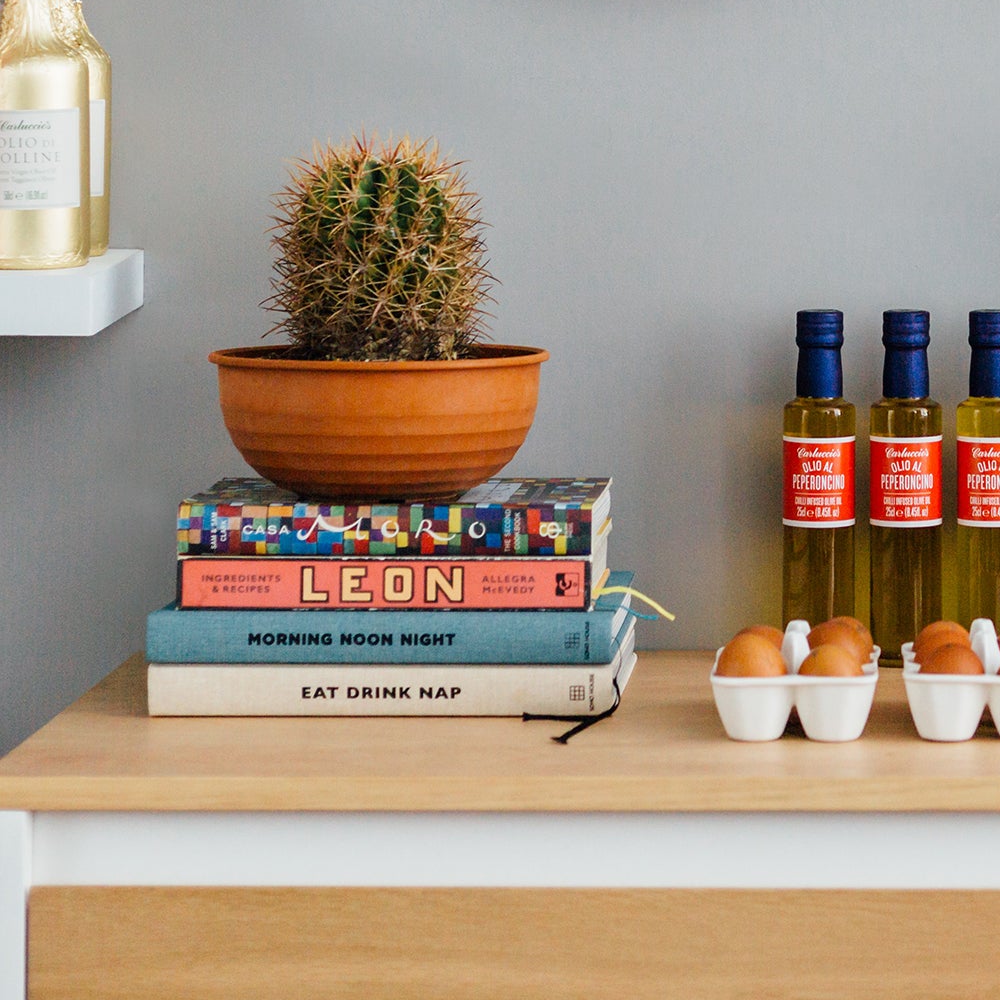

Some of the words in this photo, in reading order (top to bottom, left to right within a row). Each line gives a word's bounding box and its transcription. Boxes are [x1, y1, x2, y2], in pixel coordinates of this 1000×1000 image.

[797, 447, 841, 459] Carluccio's
[885, 447, 929, 459] Carluccio's
[802, 460, 822, 473] OLIO
[823, 460, 834, 474] AL
[890, 460, 911, 473] OLIO
[912, 460, 923, 474] AL
[977, 460, 997, 473] OLIO
[792, 474, 845, 490] PEPERONCINO
[881, 474, 934, 490] PEPERONCINO
[242, 525, 290, 535] CASA
[202, 575, 281, 583] INGREDIENTS
[300, 565, 464, 603] LEON
[482, 575, 535, 583] ALLEGRA
[212, 585, 219, 593] &
[223, 585, 270, 593] RECIPES
[482, 586, 535, 594] McEVEDY
[247, 632, 333, 646] MORNING
[340, 632, 393, 646] NOON
[401, 632, 456, 646] NIGHT
[301, 686, 339, 699] EAT
[347, 686, 411, 699] DRINK
[419, 686, 462, 699] NAP
